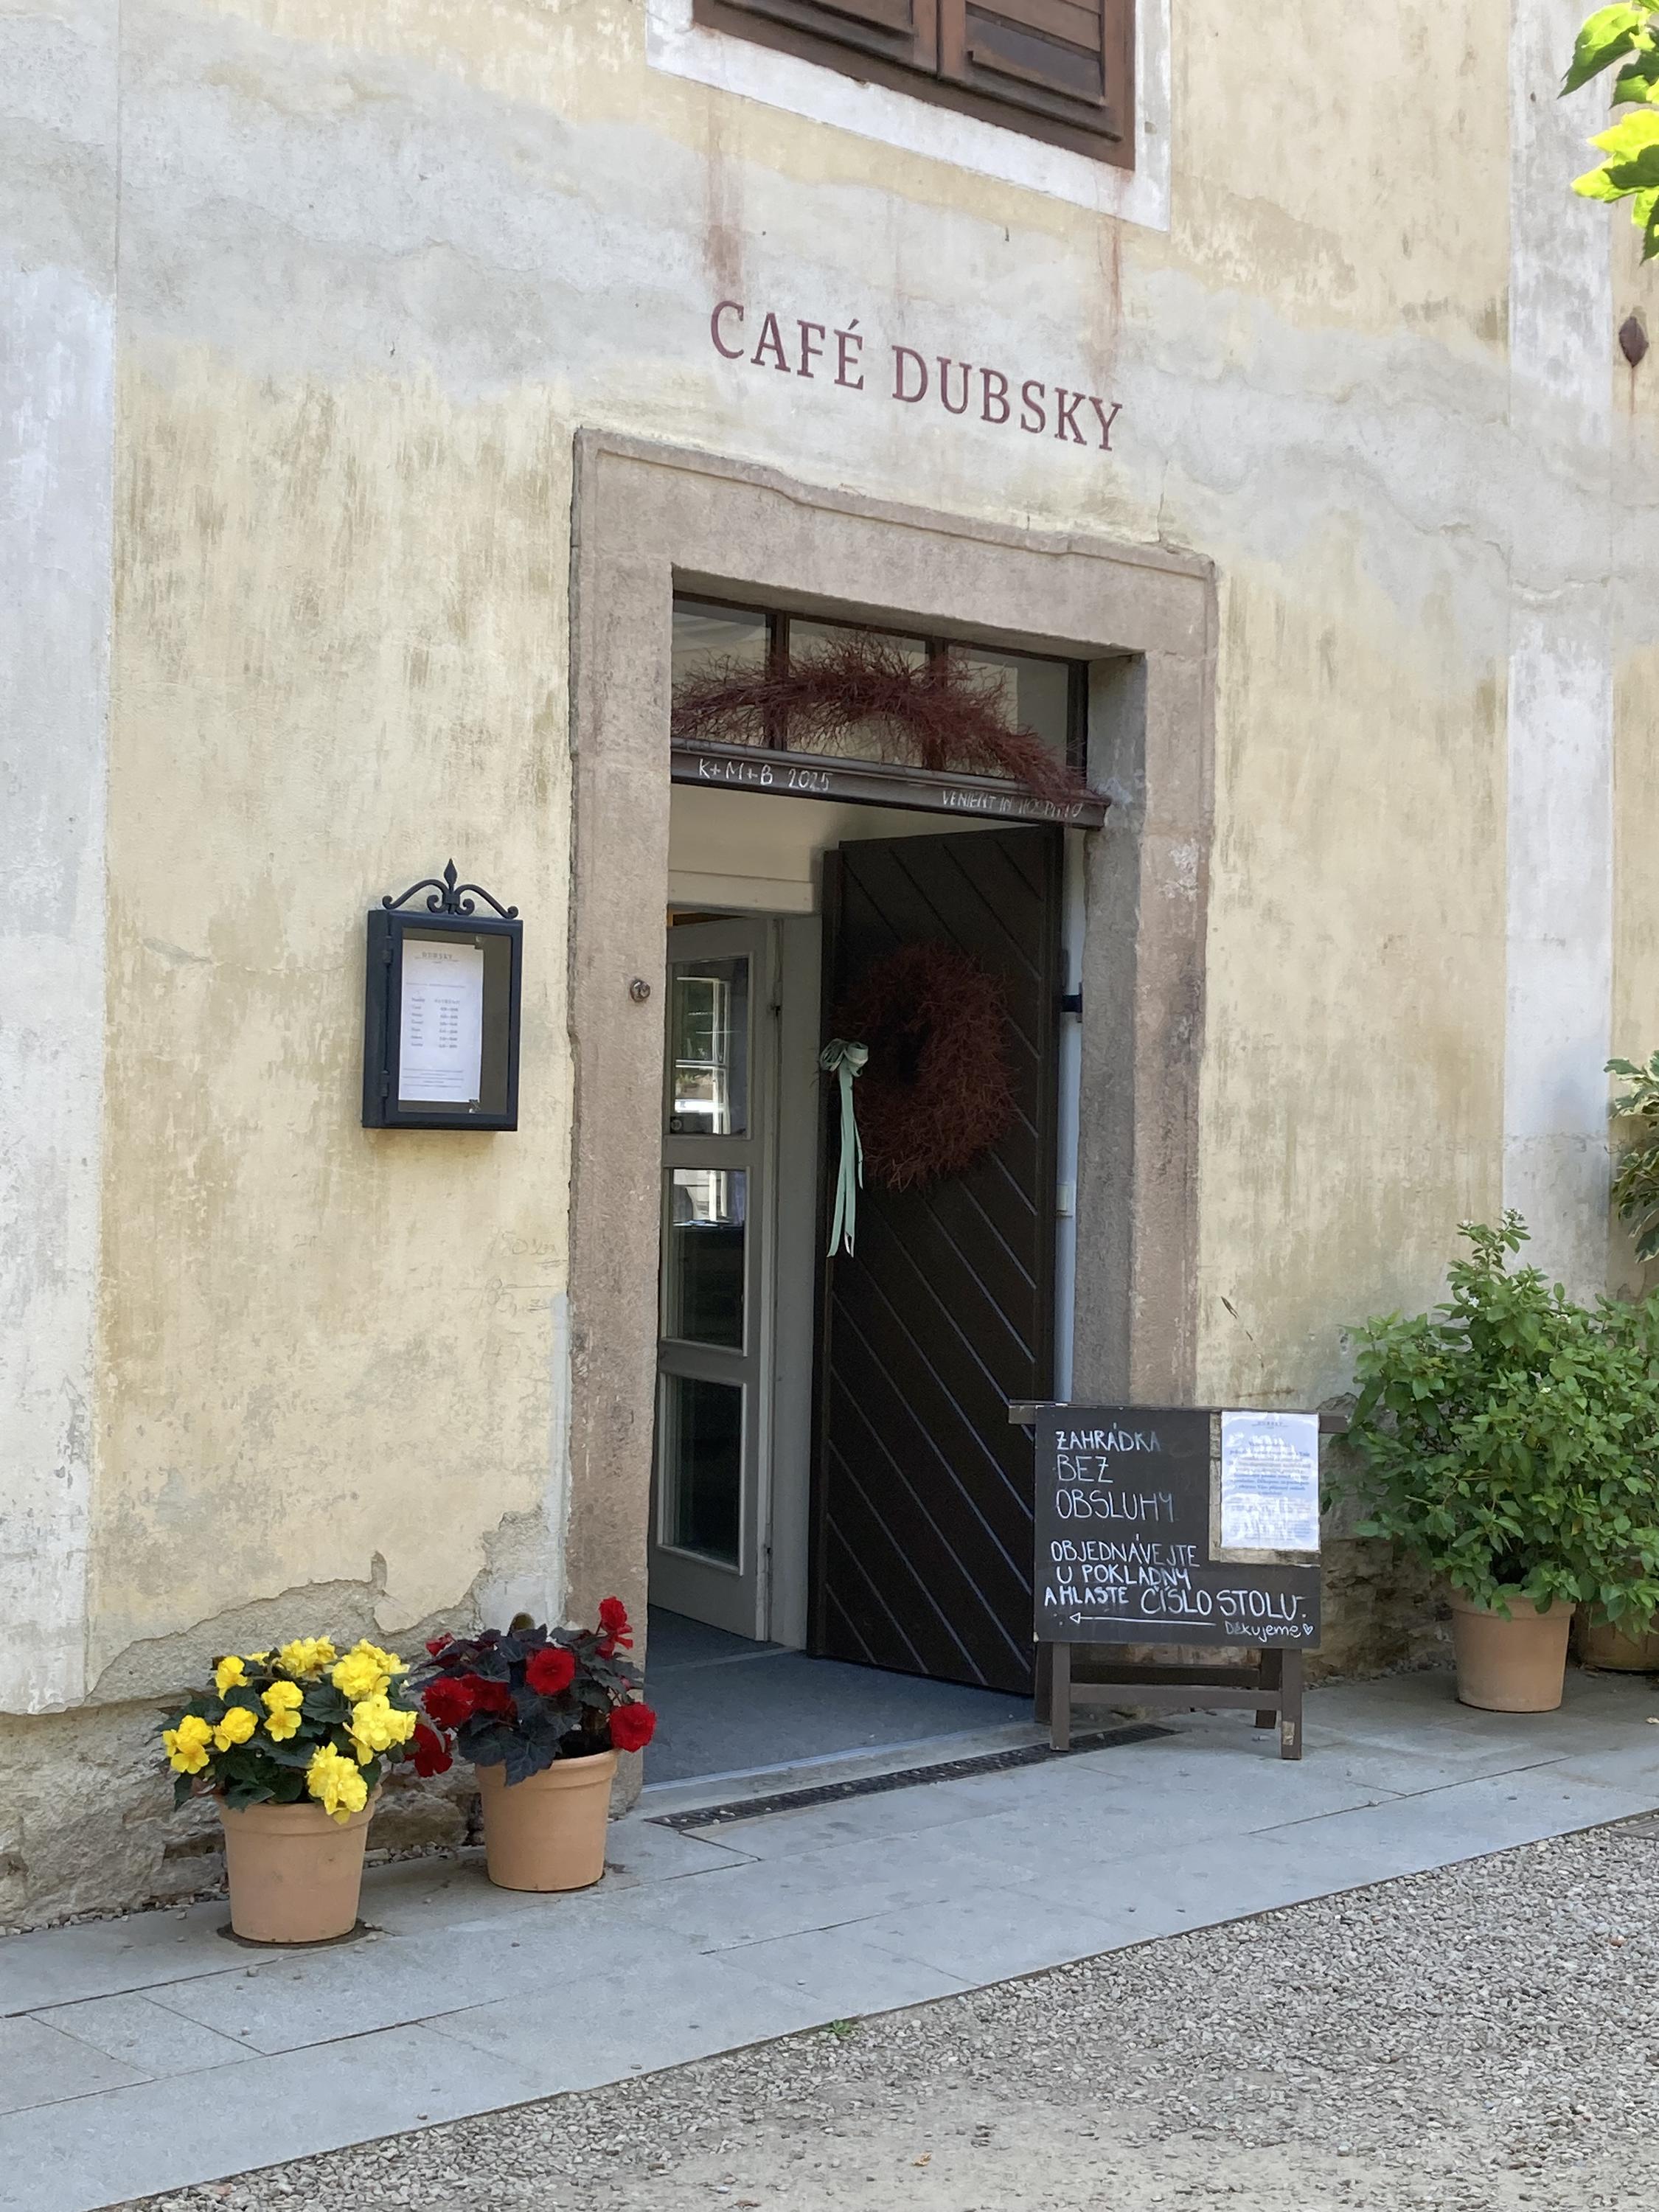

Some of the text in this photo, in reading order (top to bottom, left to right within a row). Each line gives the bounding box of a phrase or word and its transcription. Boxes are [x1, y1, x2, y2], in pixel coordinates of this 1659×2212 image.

[710, 299, 1123, 451] CAFÉ DUBSKY
[788, 768, 832, 792] 2025
[1055, 1422, 1161, 1453] ZAHRÁDKA
[1057, 1453, 1114, 1484] BEZ
[1056, 1488, 1174, 1523] OBSLUHY
[1056, 1564, 1192, 1590] U POKLADNY
